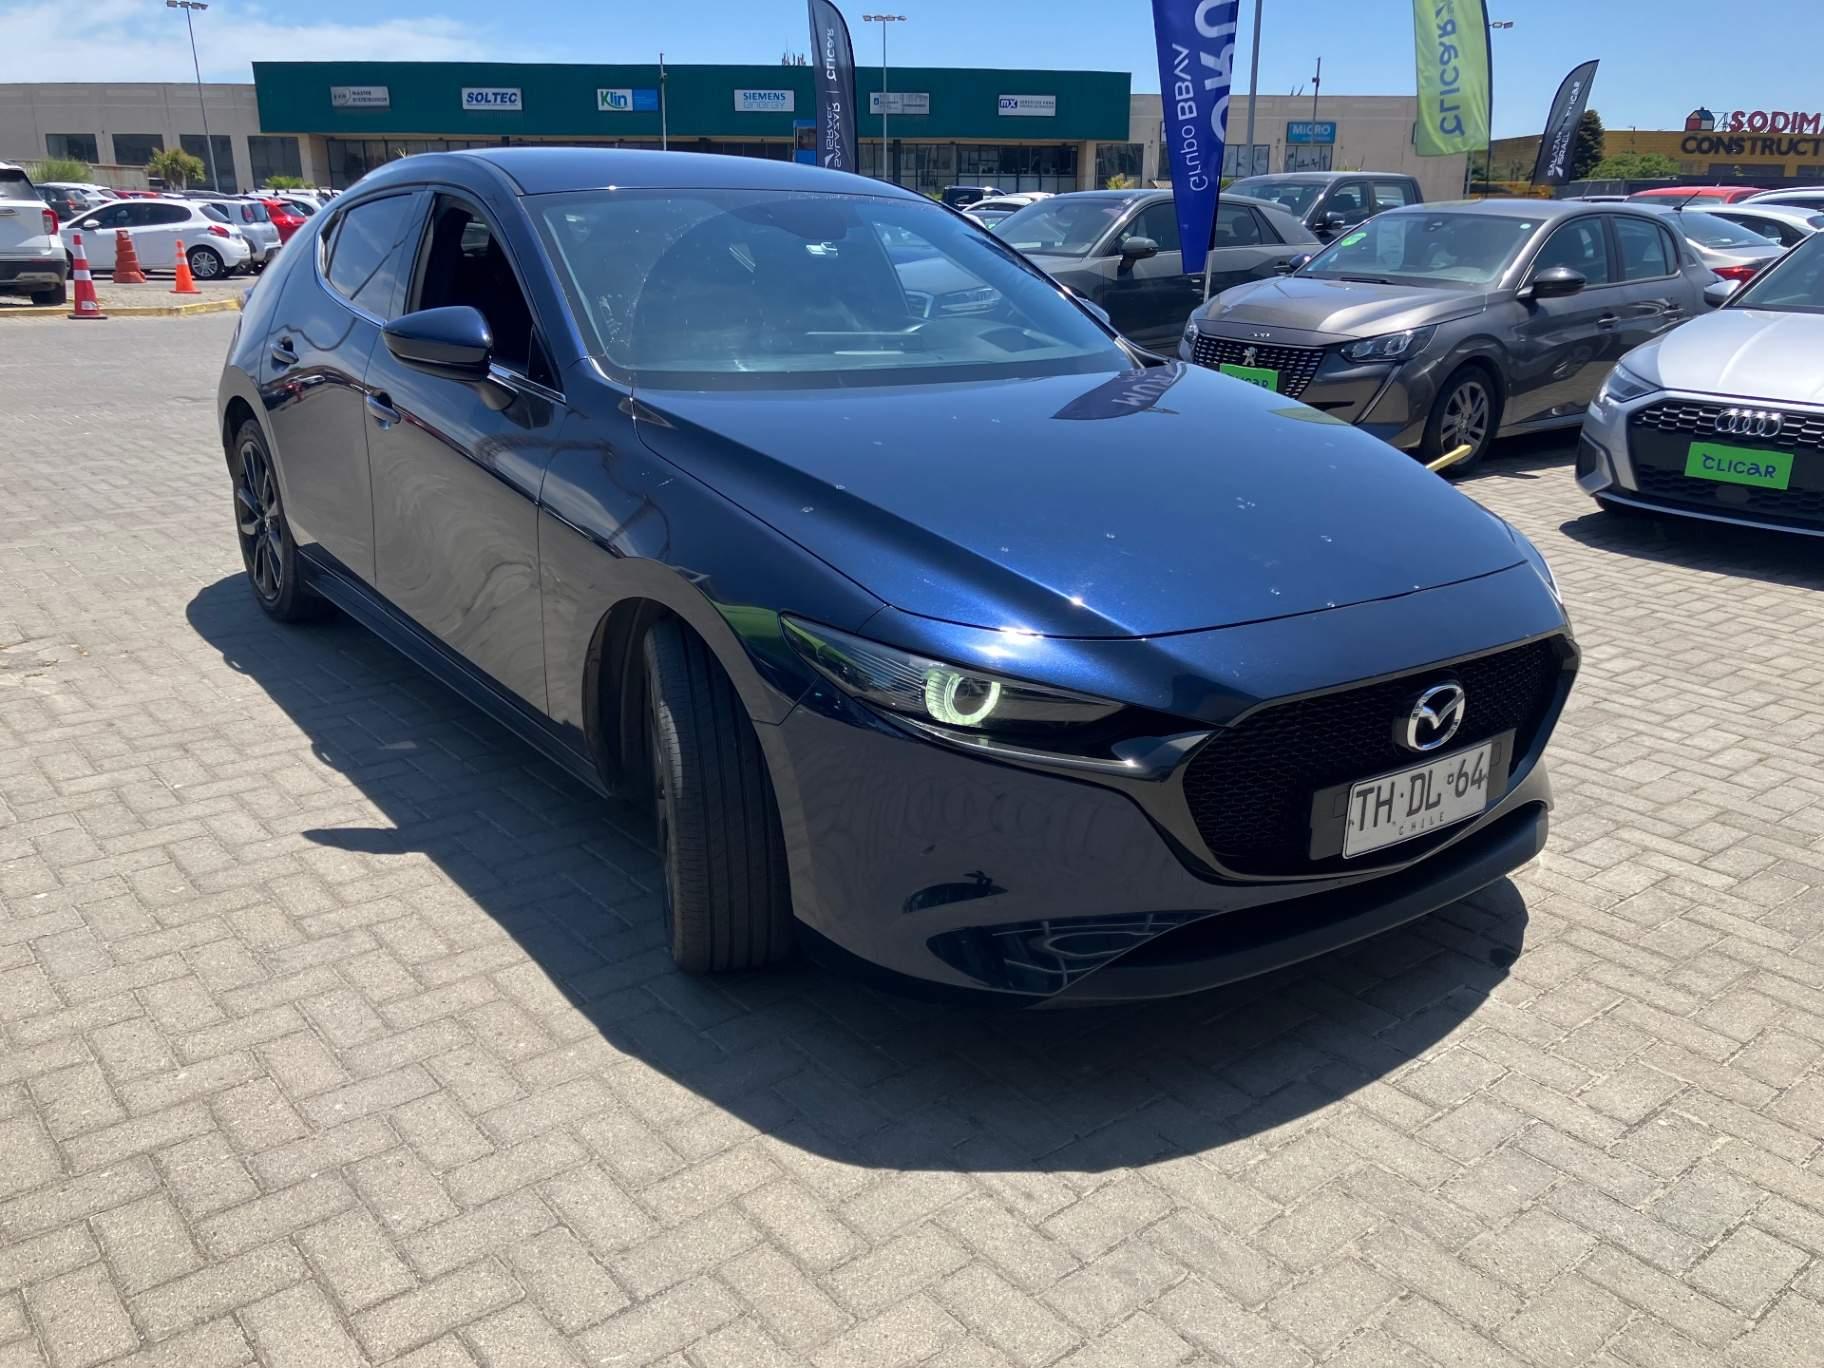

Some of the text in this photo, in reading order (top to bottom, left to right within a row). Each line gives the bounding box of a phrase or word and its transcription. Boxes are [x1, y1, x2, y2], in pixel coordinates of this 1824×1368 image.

[466, 92, 517, 104] SOLTEC
[600, 91, 627, 107] Klin
[744, 92, 786, 101] SIEMENS
[1728, 110, 1824, 134] SODIM
[1681, 136, 1824, 156] CONSTRUCT
[1399, 811, 1445, 835] CHILE
